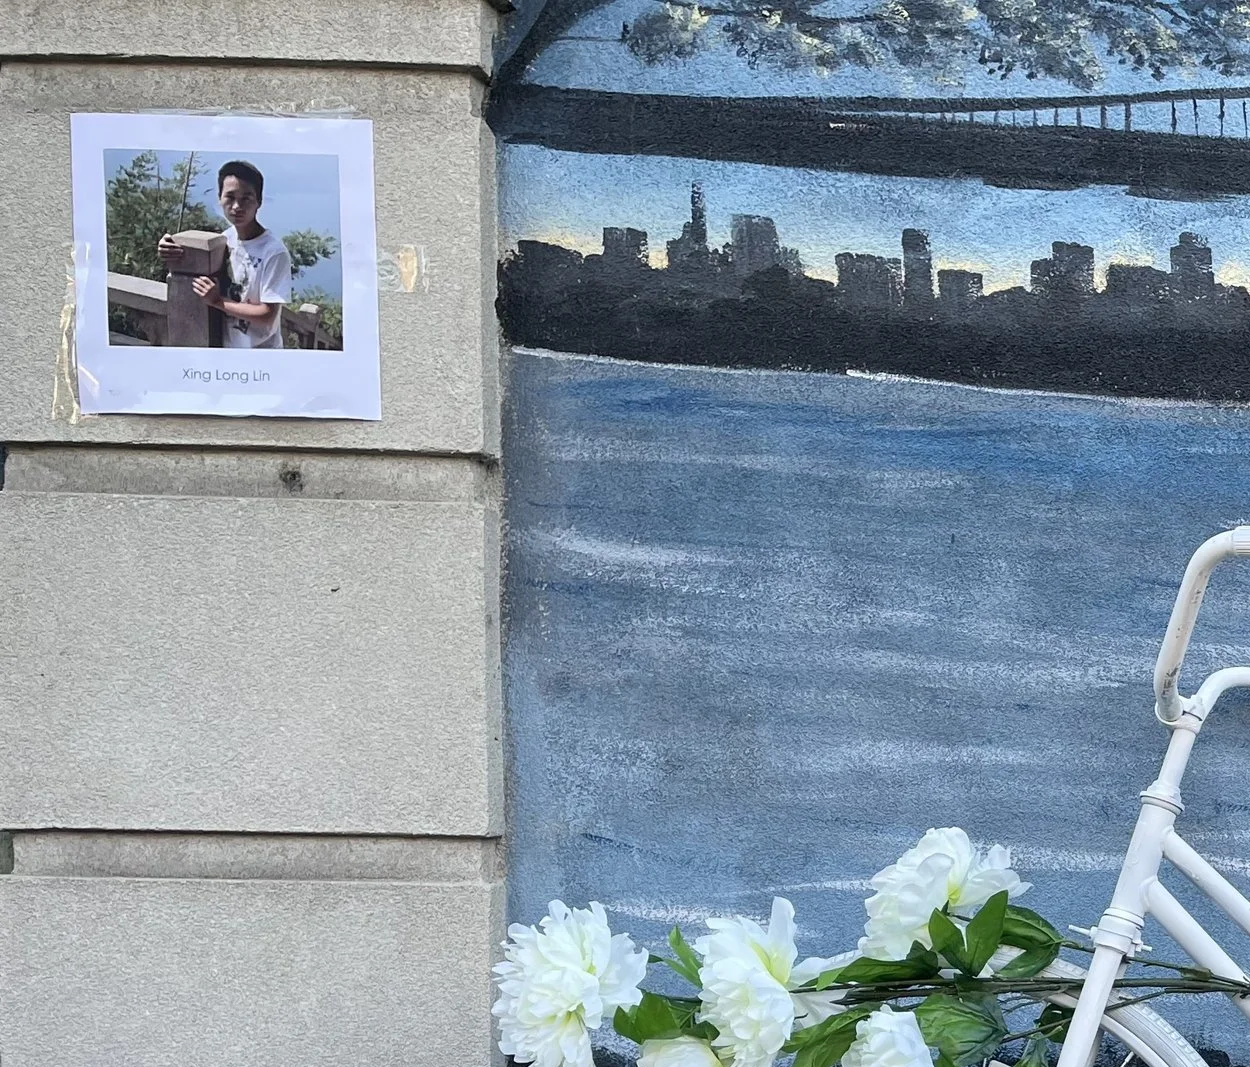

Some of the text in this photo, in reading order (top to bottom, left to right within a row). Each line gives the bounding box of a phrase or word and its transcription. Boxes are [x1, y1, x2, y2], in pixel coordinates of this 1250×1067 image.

[182, 368, 271, 384] Xing Long Lin
